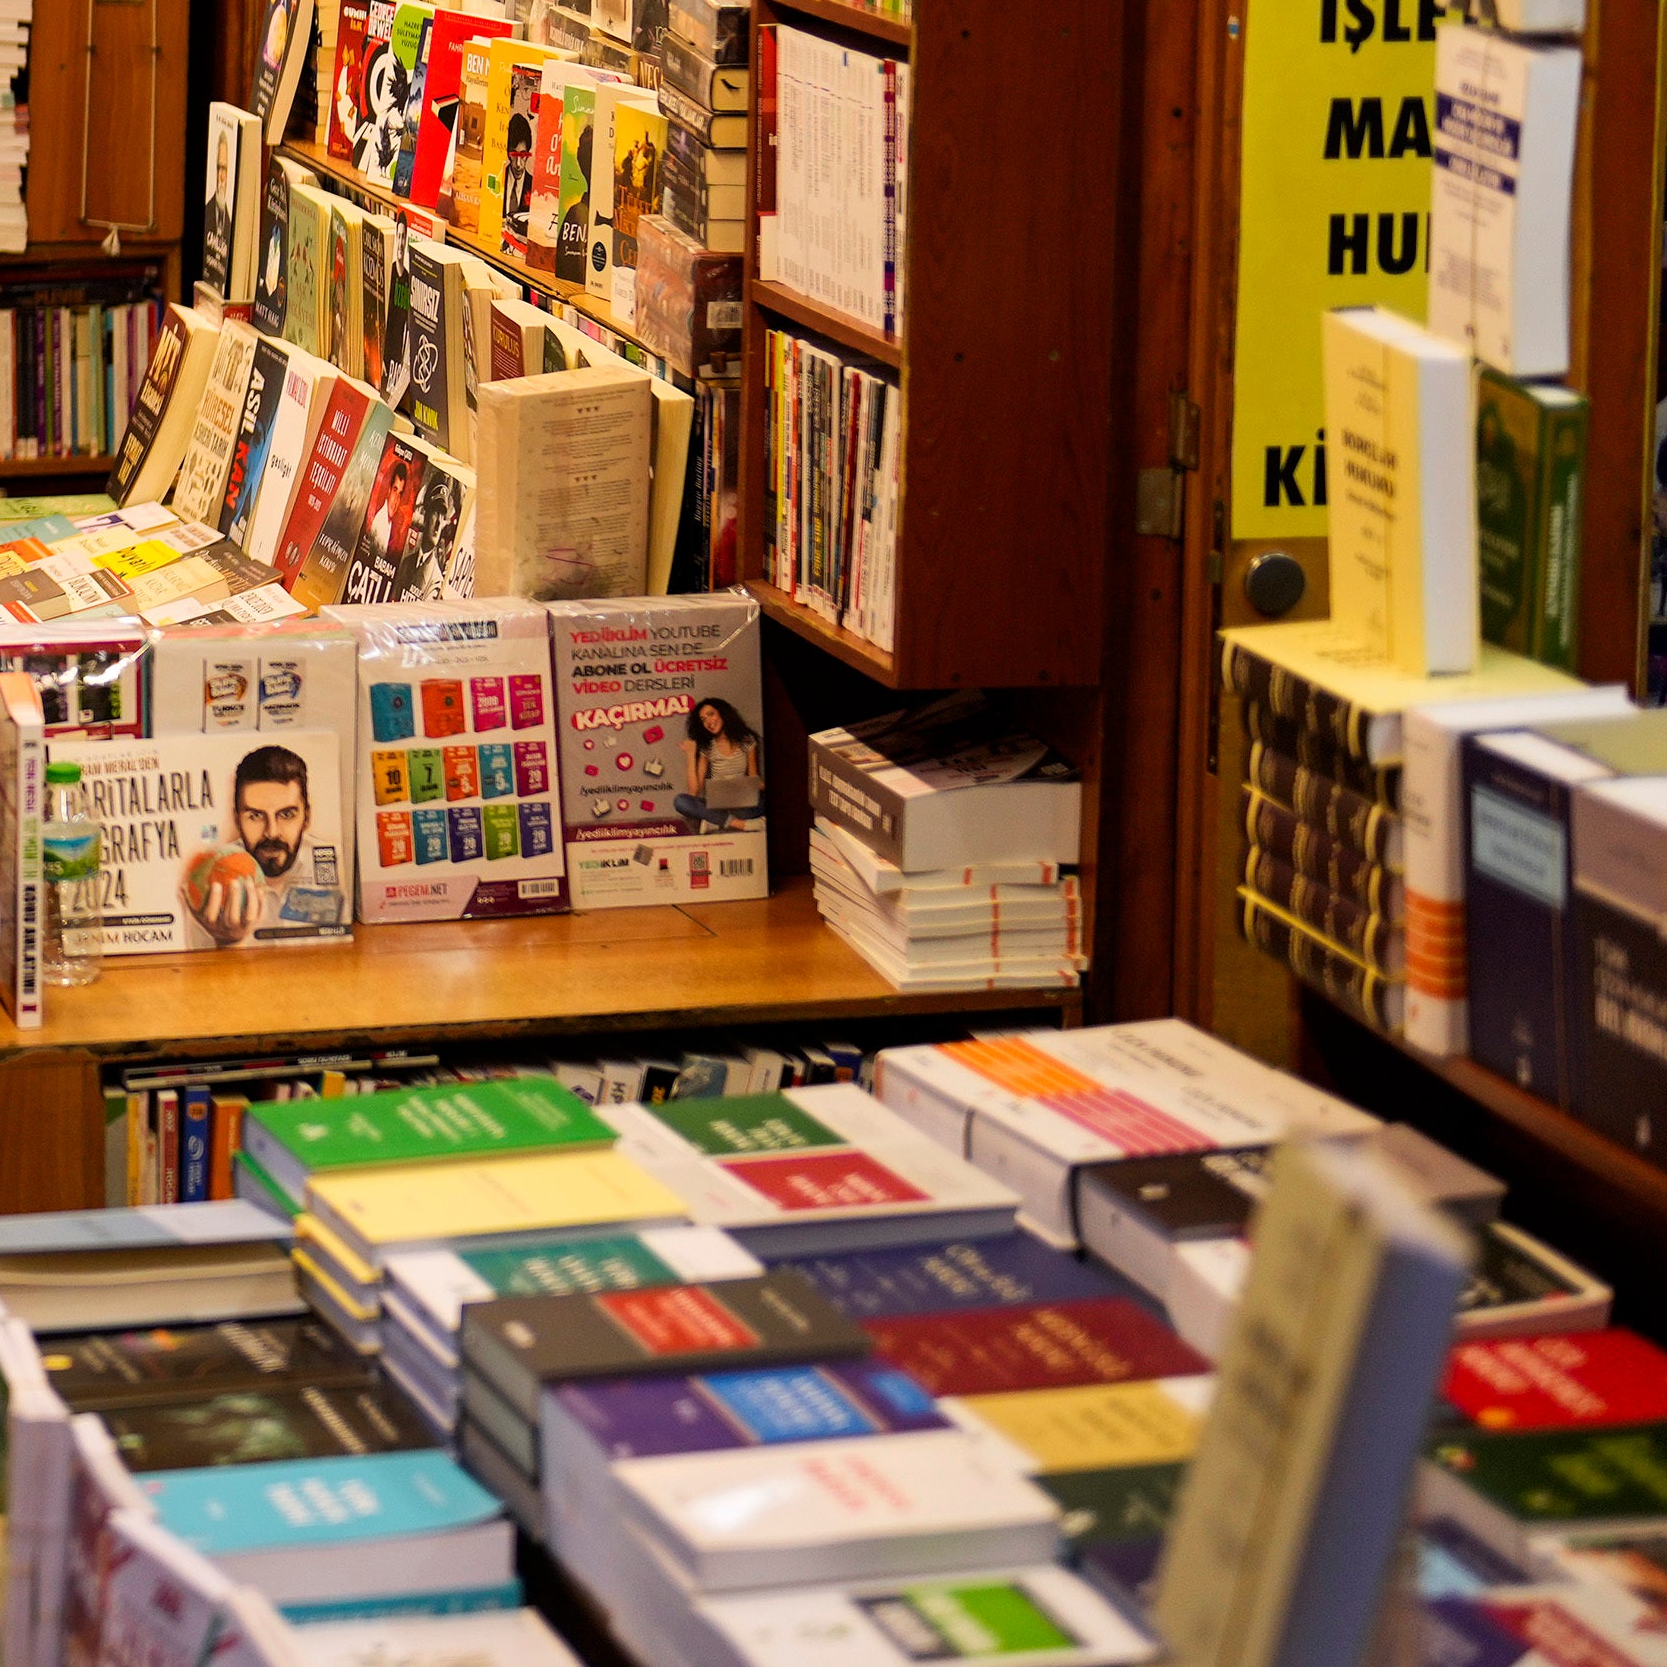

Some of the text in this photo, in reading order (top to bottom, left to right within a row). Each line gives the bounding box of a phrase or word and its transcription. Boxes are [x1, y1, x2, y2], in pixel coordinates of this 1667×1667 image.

[370, 0, 395, 19] GEORGE
[333, 409, 350, 437] MİLLİ
[374, 555, 397, 579] BABAM
[649, 625, 720, 640] YOUTUBE
[571, 642, 703, 660] KANALINA SEN DE
[571, 655, 728, 677] ABONE OL ÜCRETSİZ
[572, 677, 695, 694] VİDEO DERSLERİ
[574, 695, 690, 731] KAÇIRMA!
[124, 928, 173, 943] HOCAM
